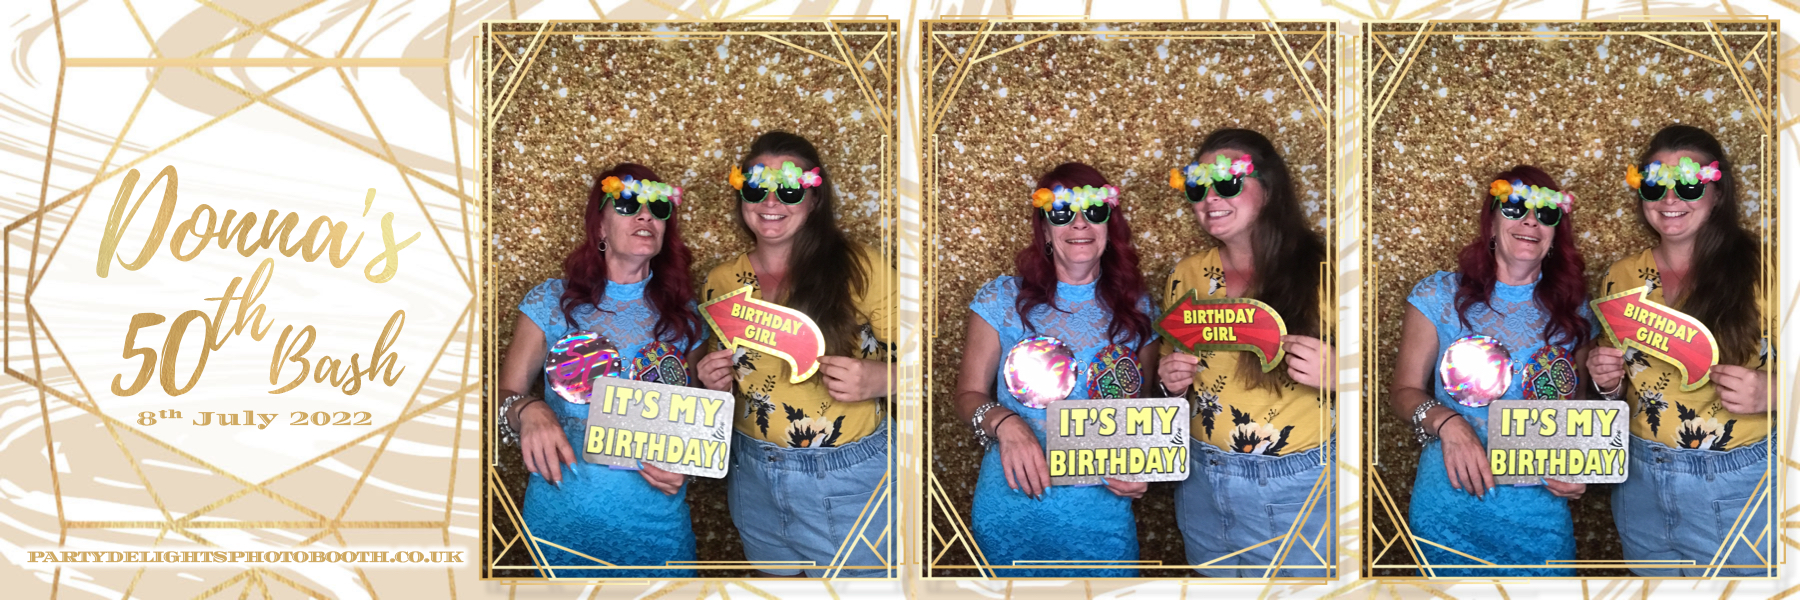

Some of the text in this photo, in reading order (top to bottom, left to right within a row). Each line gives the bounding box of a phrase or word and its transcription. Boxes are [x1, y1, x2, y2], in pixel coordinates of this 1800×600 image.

[731, 302, 803, 336] BIRTHDAY
[1183, 307, 1256, 325] BIRTHDAY
[1623, 302, 1699, 344] BIRTHDAY
[744, 324, 778, 348] GIRL
[1202, 326, 1238, 342] GIRL
[1636, 326, 1671, 353] GIRL
[602, 385, 724, 427] IT'S MY
[1059, 406, 1180, 438] IT'S MY
[1500, 408, 1619, 437] IT'S MY
[586, 425, 728, 471] BIRTHDAY!
[1050, 446, 1187, 478] BIRTHDAY!
[1490, 448, 1626, 477] BIRTHDAY!
